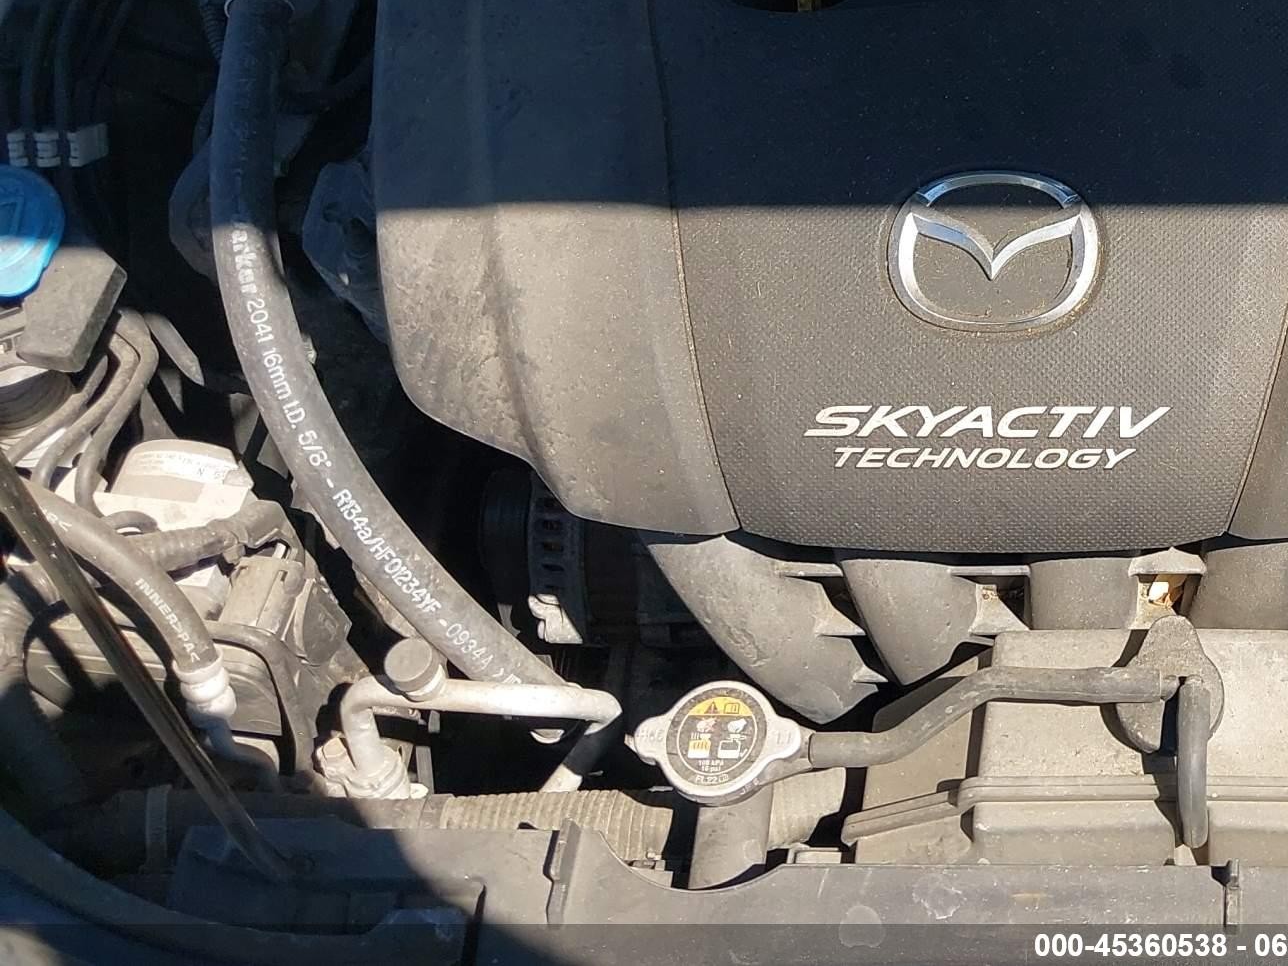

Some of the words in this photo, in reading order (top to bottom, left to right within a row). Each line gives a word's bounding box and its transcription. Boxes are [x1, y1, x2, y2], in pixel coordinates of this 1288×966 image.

[246, 298, 274, 344] 2041
[262, 348, 292, 401] 16mm
[282, 400, 307, 429] I.D.
[803, 404, 1172, 439] SKYACTIV
[833, 446, 1137, 470] TECHNOLOGY
